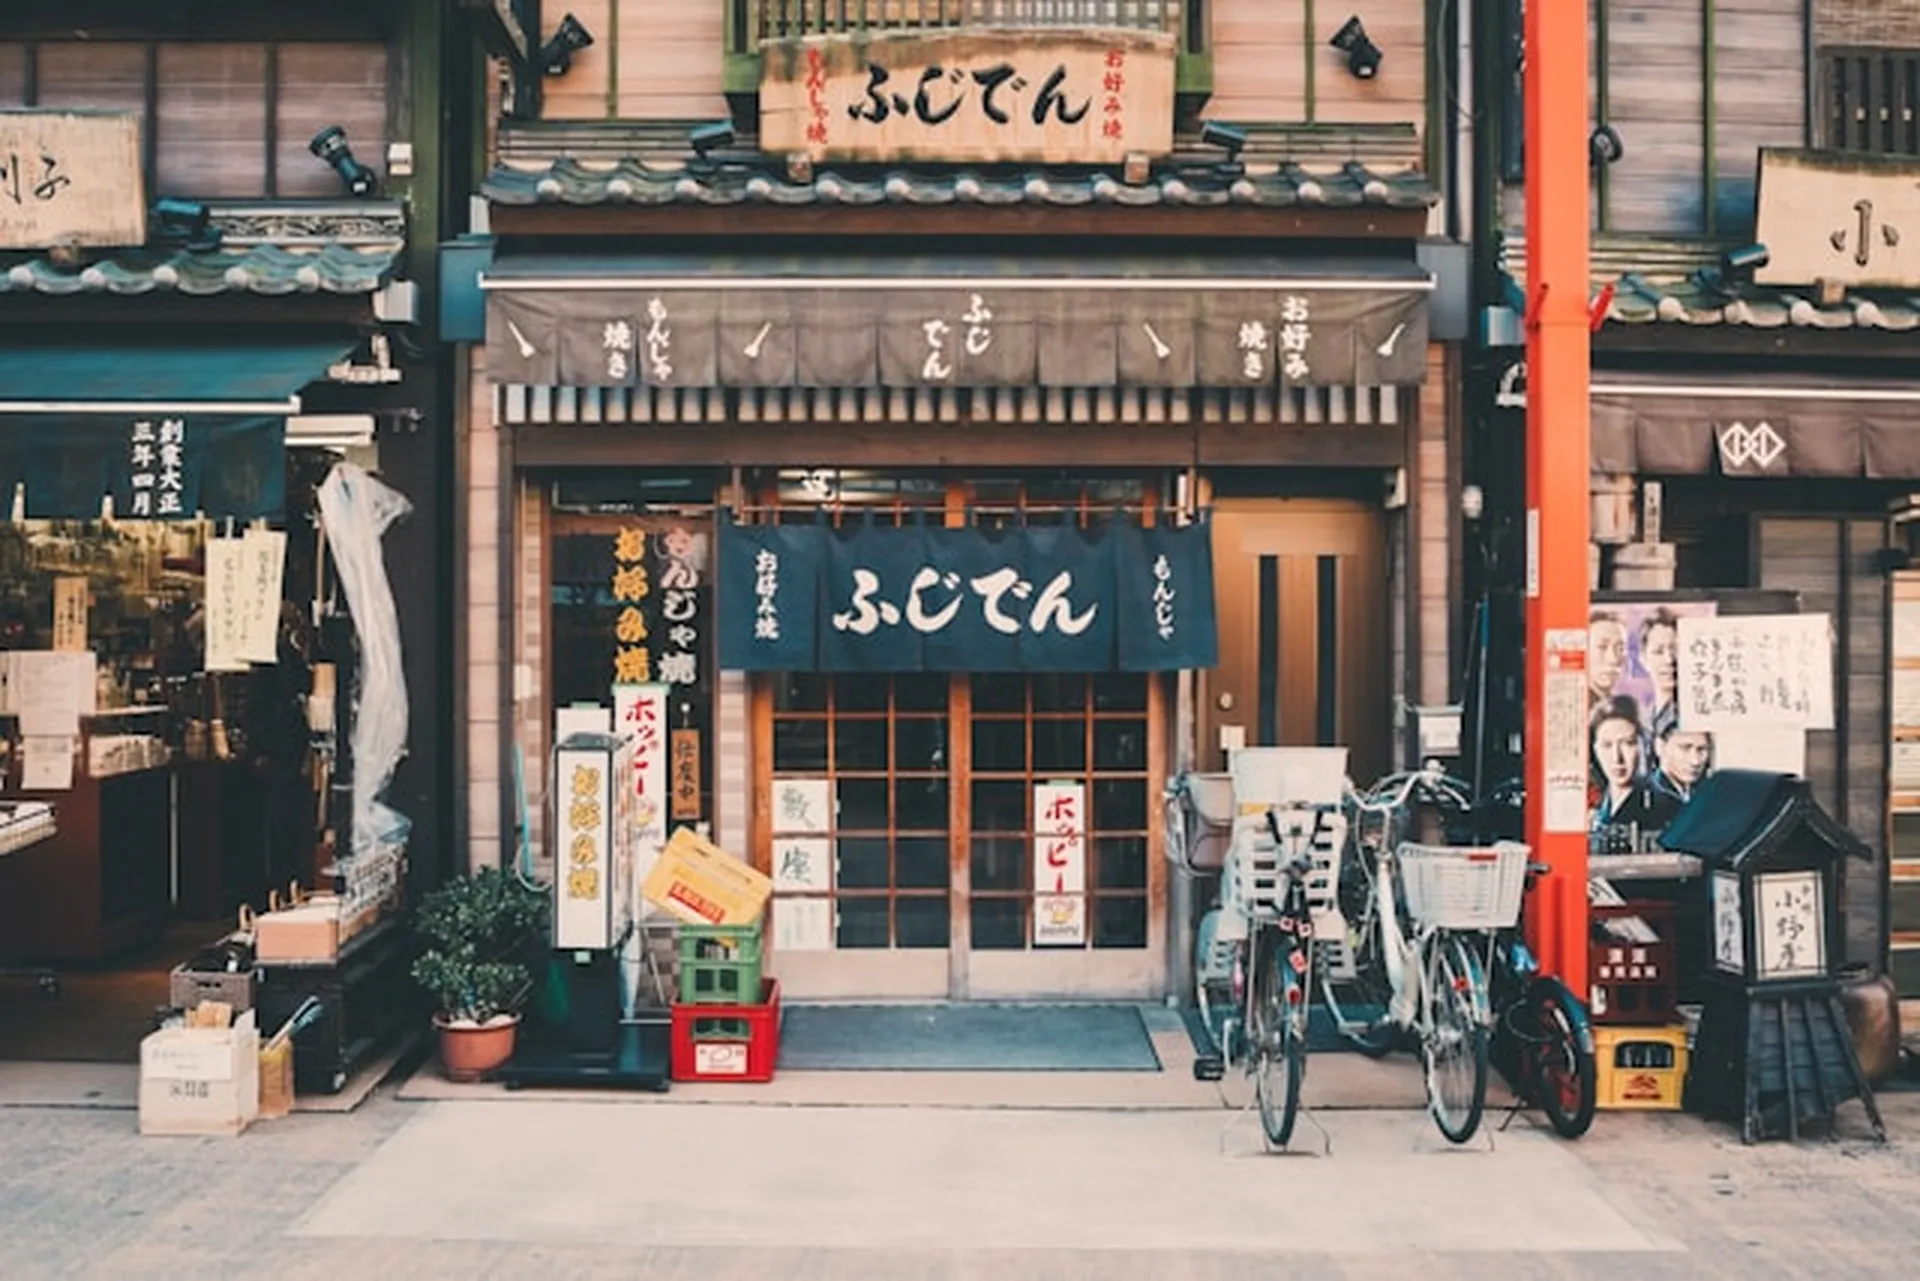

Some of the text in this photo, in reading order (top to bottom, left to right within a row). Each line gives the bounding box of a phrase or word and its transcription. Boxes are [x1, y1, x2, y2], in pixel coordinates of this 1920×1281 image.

[848, 63, 1093, 125] ふじでん
[603, 320, 632, 379] 焼き
[922, 320, 952, 379] でん
[962, 292, 992, 355] ふじ
[1238, 320, 1268, 379] 焼き
[1281, 296, 1312, 379] お好み
[131, 421, 155, 516] 三年四月
[832, 566, 1098, 635] ふじでん
[624, 697, 659, 796] ホッピー
[1043, 796, 1078, 896] ホッピー
